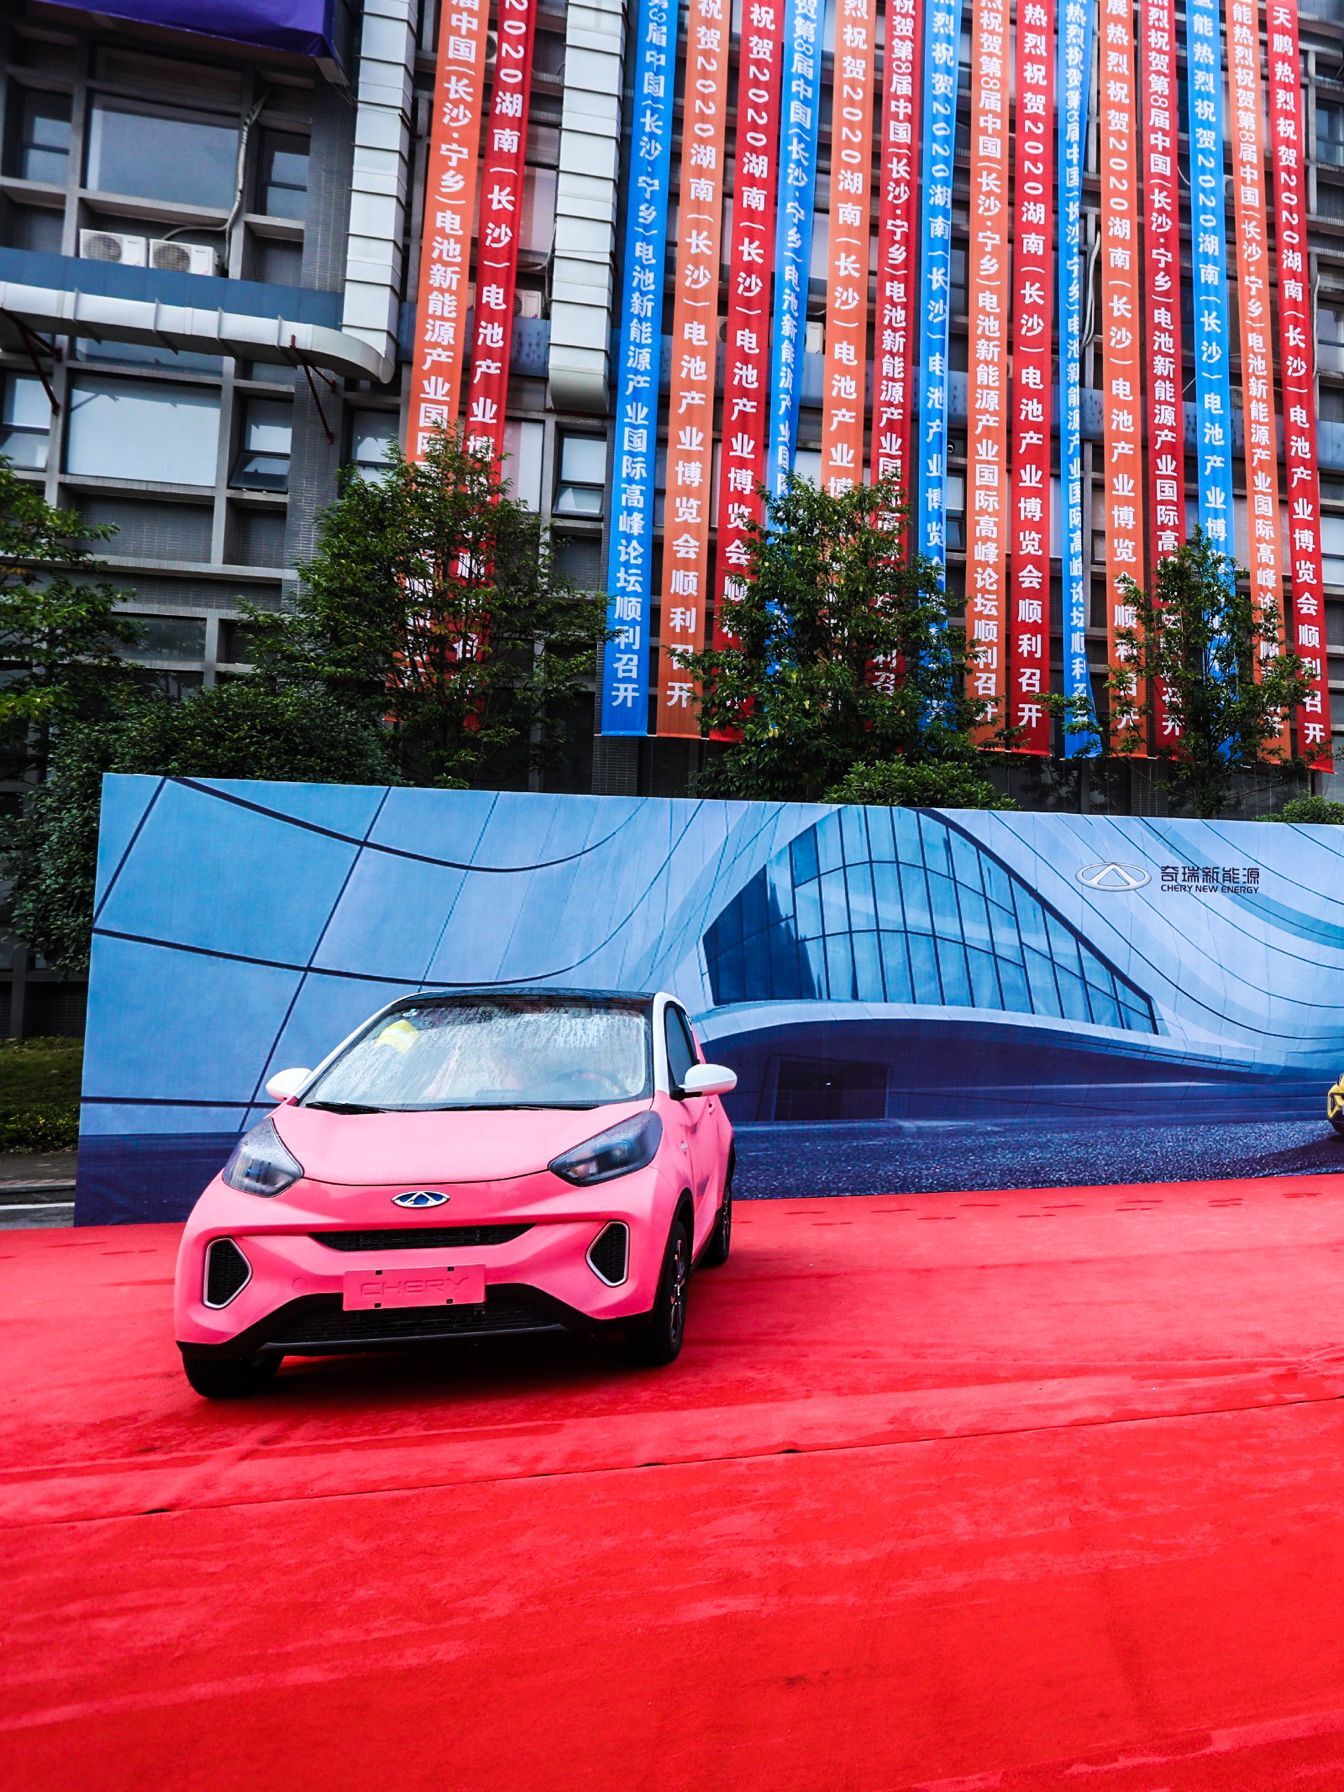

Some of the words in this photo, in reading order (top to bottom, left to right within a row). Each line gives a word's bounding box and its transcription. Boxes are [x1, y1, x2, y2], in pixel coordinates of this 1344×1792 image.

[723, 4, 776, 710] 祝贺2020湖南（长沙）电池产业博览会顺
[1017, 3, 1047, 728] 热烈祝贺2020湖南（长沙）电池产业博览会顺利召开
[1160, 865, 1260, 885] 奇瑞新能源
[1160, 884, 1193, 893] CHERY
[1195, 885, 1218, 893] NEW
[1221, 885, 1259, 894] ENERGY
[360, 1276, 470, 1297] CHERY
